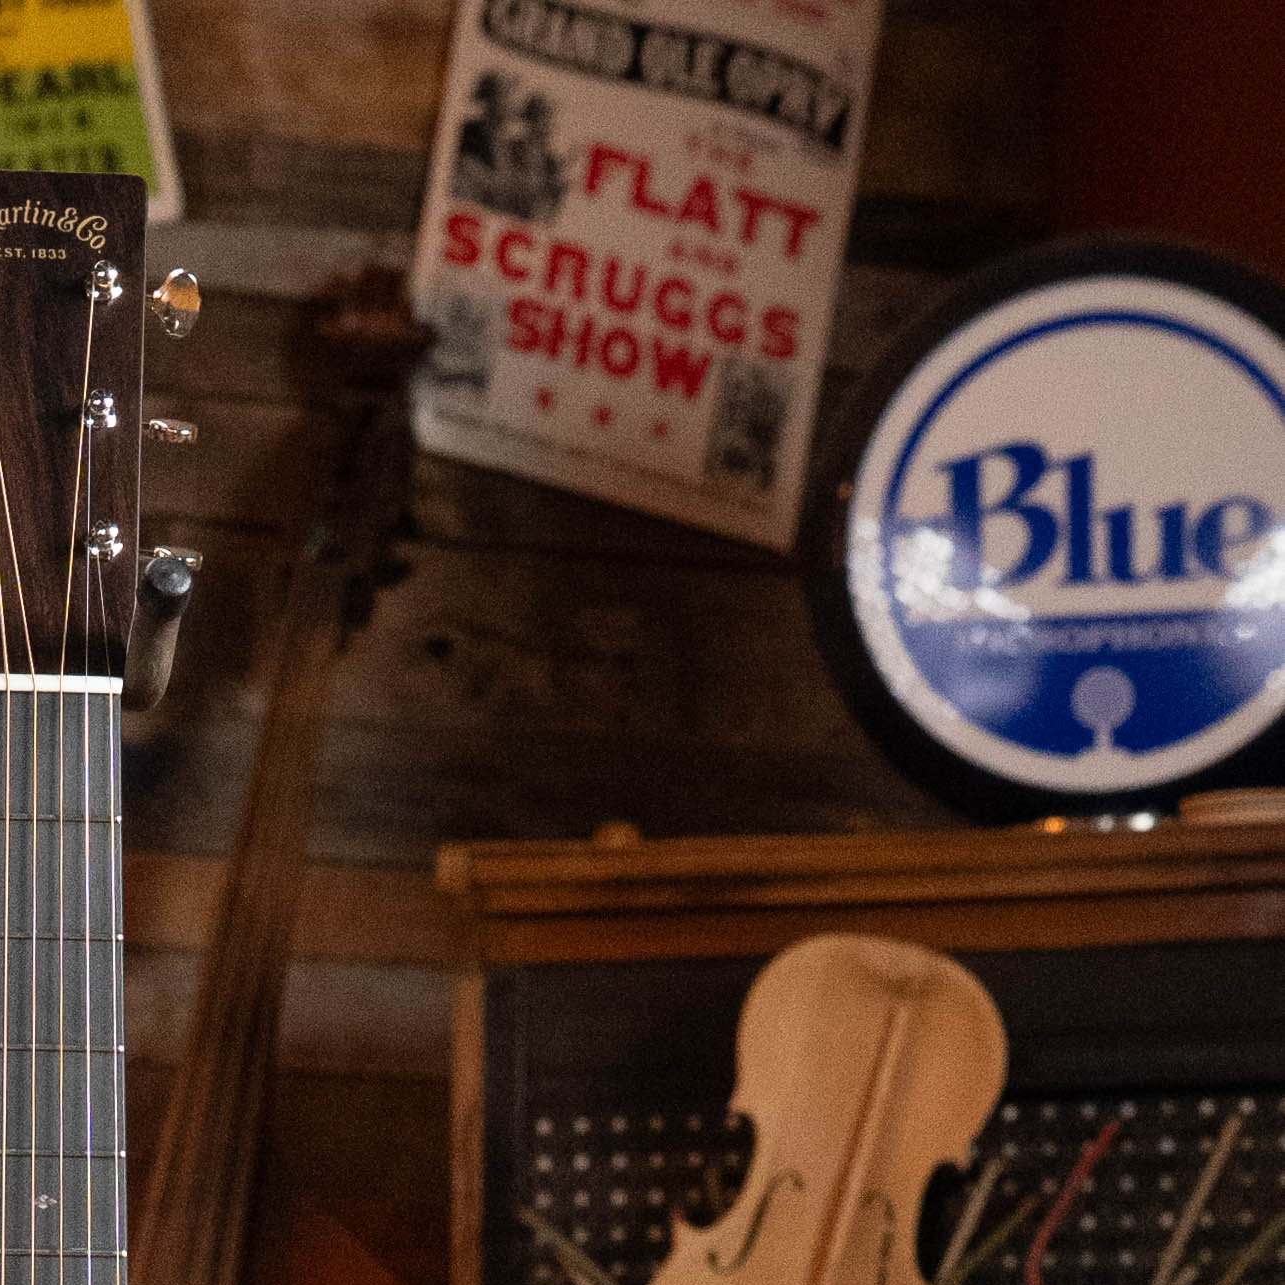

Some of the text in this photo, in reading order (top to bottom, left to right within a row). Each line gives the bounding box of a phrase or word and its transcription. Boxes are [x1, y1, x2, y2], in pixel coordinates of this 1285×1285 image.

[31, 247, 67, 260] 1833
[583, 142, 820, 260] FLATT
[443, 211, 801, 362] SCRUGGS
[505, 296, 713, 402] SHOW
[934, 438, 1272, 590] Blue
